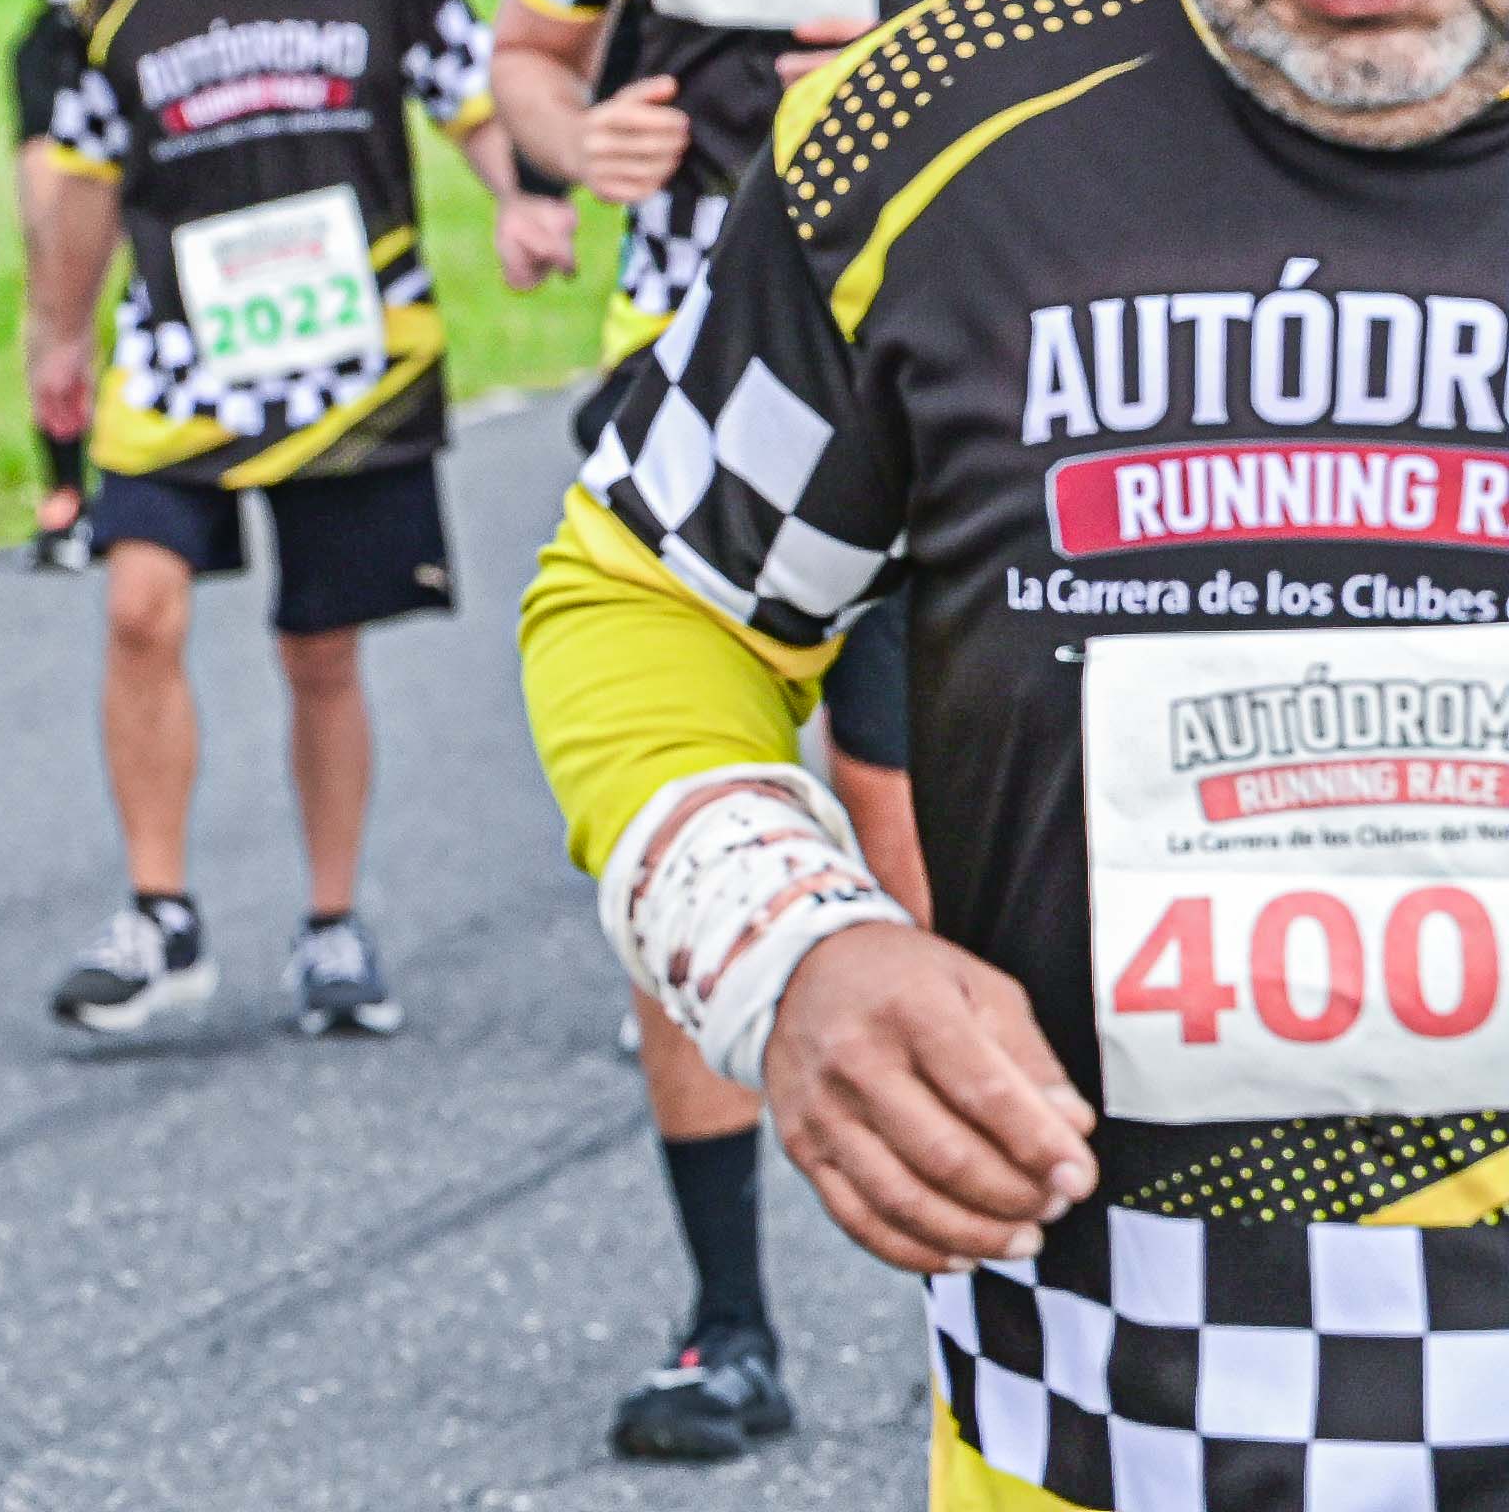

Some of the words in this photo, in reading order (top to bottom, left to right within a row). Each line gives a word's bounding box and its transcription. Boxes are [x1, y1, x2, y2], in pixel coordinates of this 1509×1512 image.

[204, 273, 363, 357] 2022
[1022, 258, 1509, 445] AUTÓDR
[1114, 452, 1438, 541] RUNNING
[1047, 568, 1190, 615] Carrera
[1198, 568, 1259, 615] de
[1266, 569, 1334, 616] los
[1341, 573, 1497, 622] Clubes
[1236, 763, 1398, 813] RUNNING
[1407, 762, 1501, 804] RACE
[1112, 884, 1500, 1045] 400
